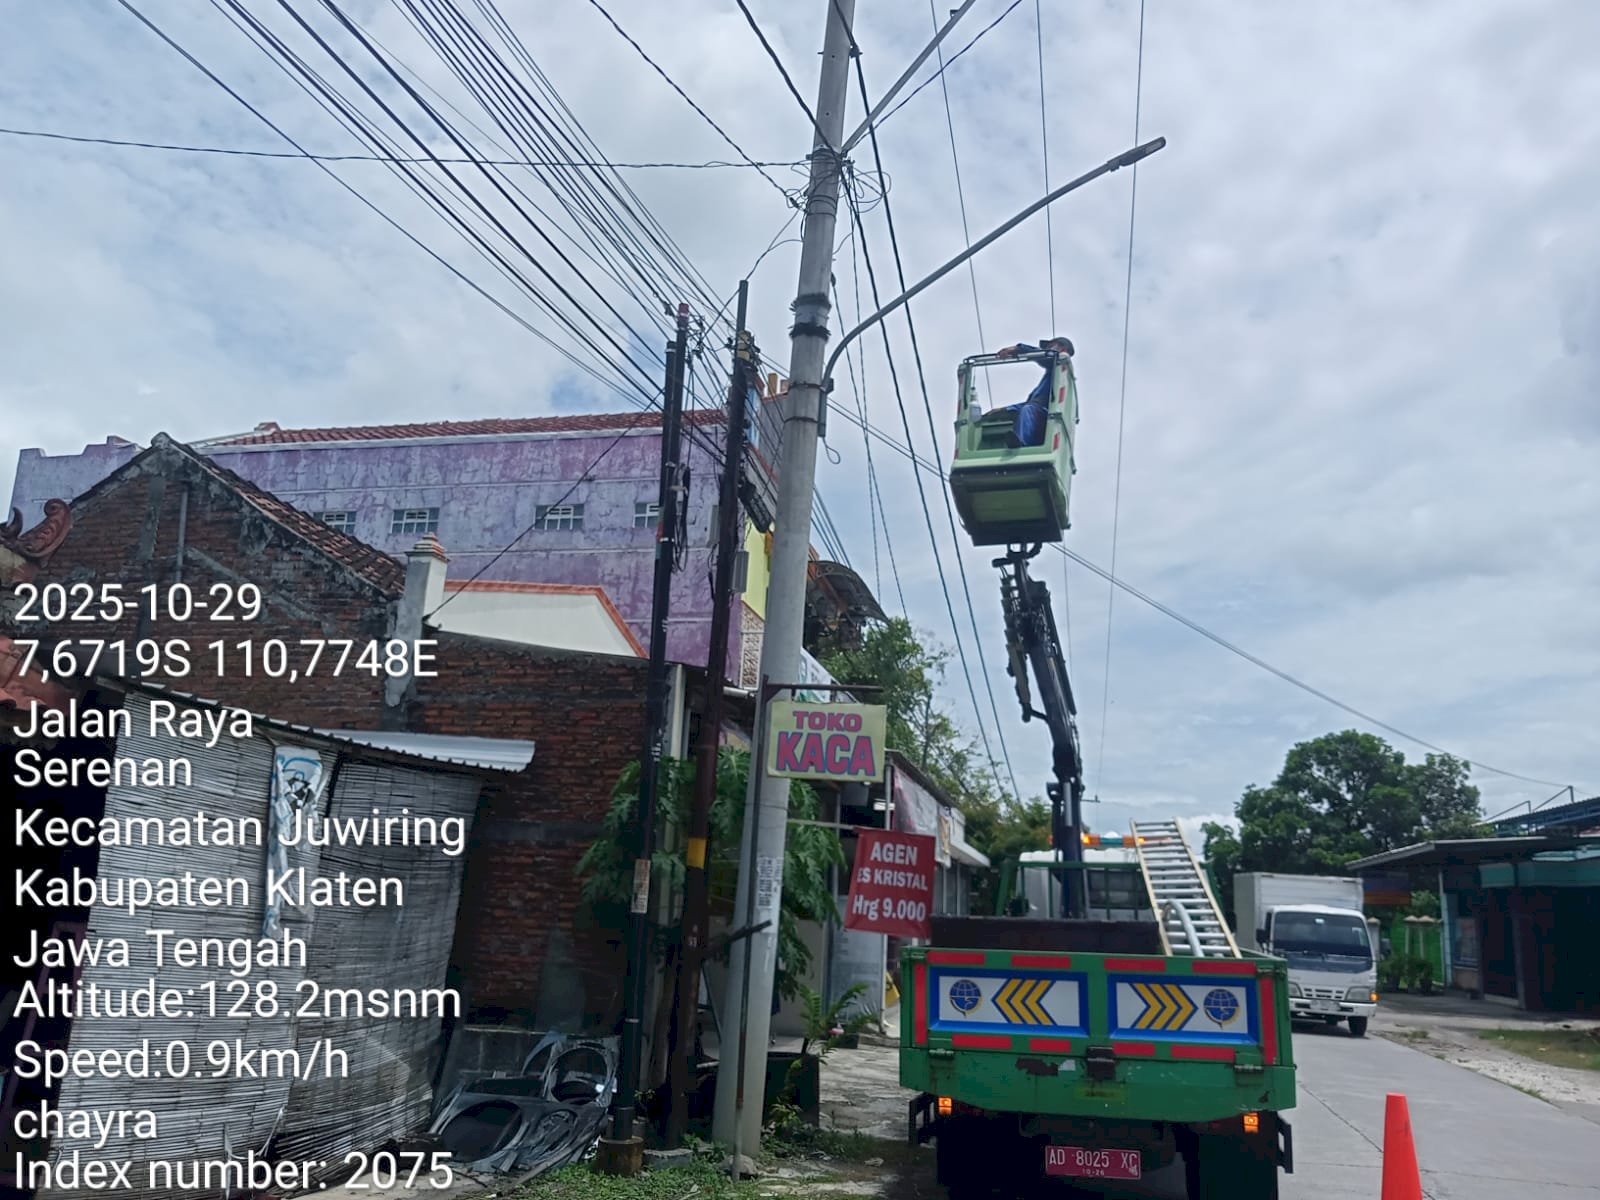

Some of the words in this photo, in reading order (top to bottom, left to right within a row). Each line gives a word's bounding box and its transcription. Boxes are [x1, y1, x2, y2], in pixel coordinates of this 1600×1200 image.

[793, 711, 862, 732] TOKO
[776, 731, 875, 776] KACA
[870, 841, 918, 866] AGEN
[874, 868, 928, 891] KRISTAL
[852, 894, 880, 921] Hrg
[883, 897, 926, 922] 9.000
[1049, 1149, 1065, 1165] AD
[1076, 1150, 1109, 1168] 8025
